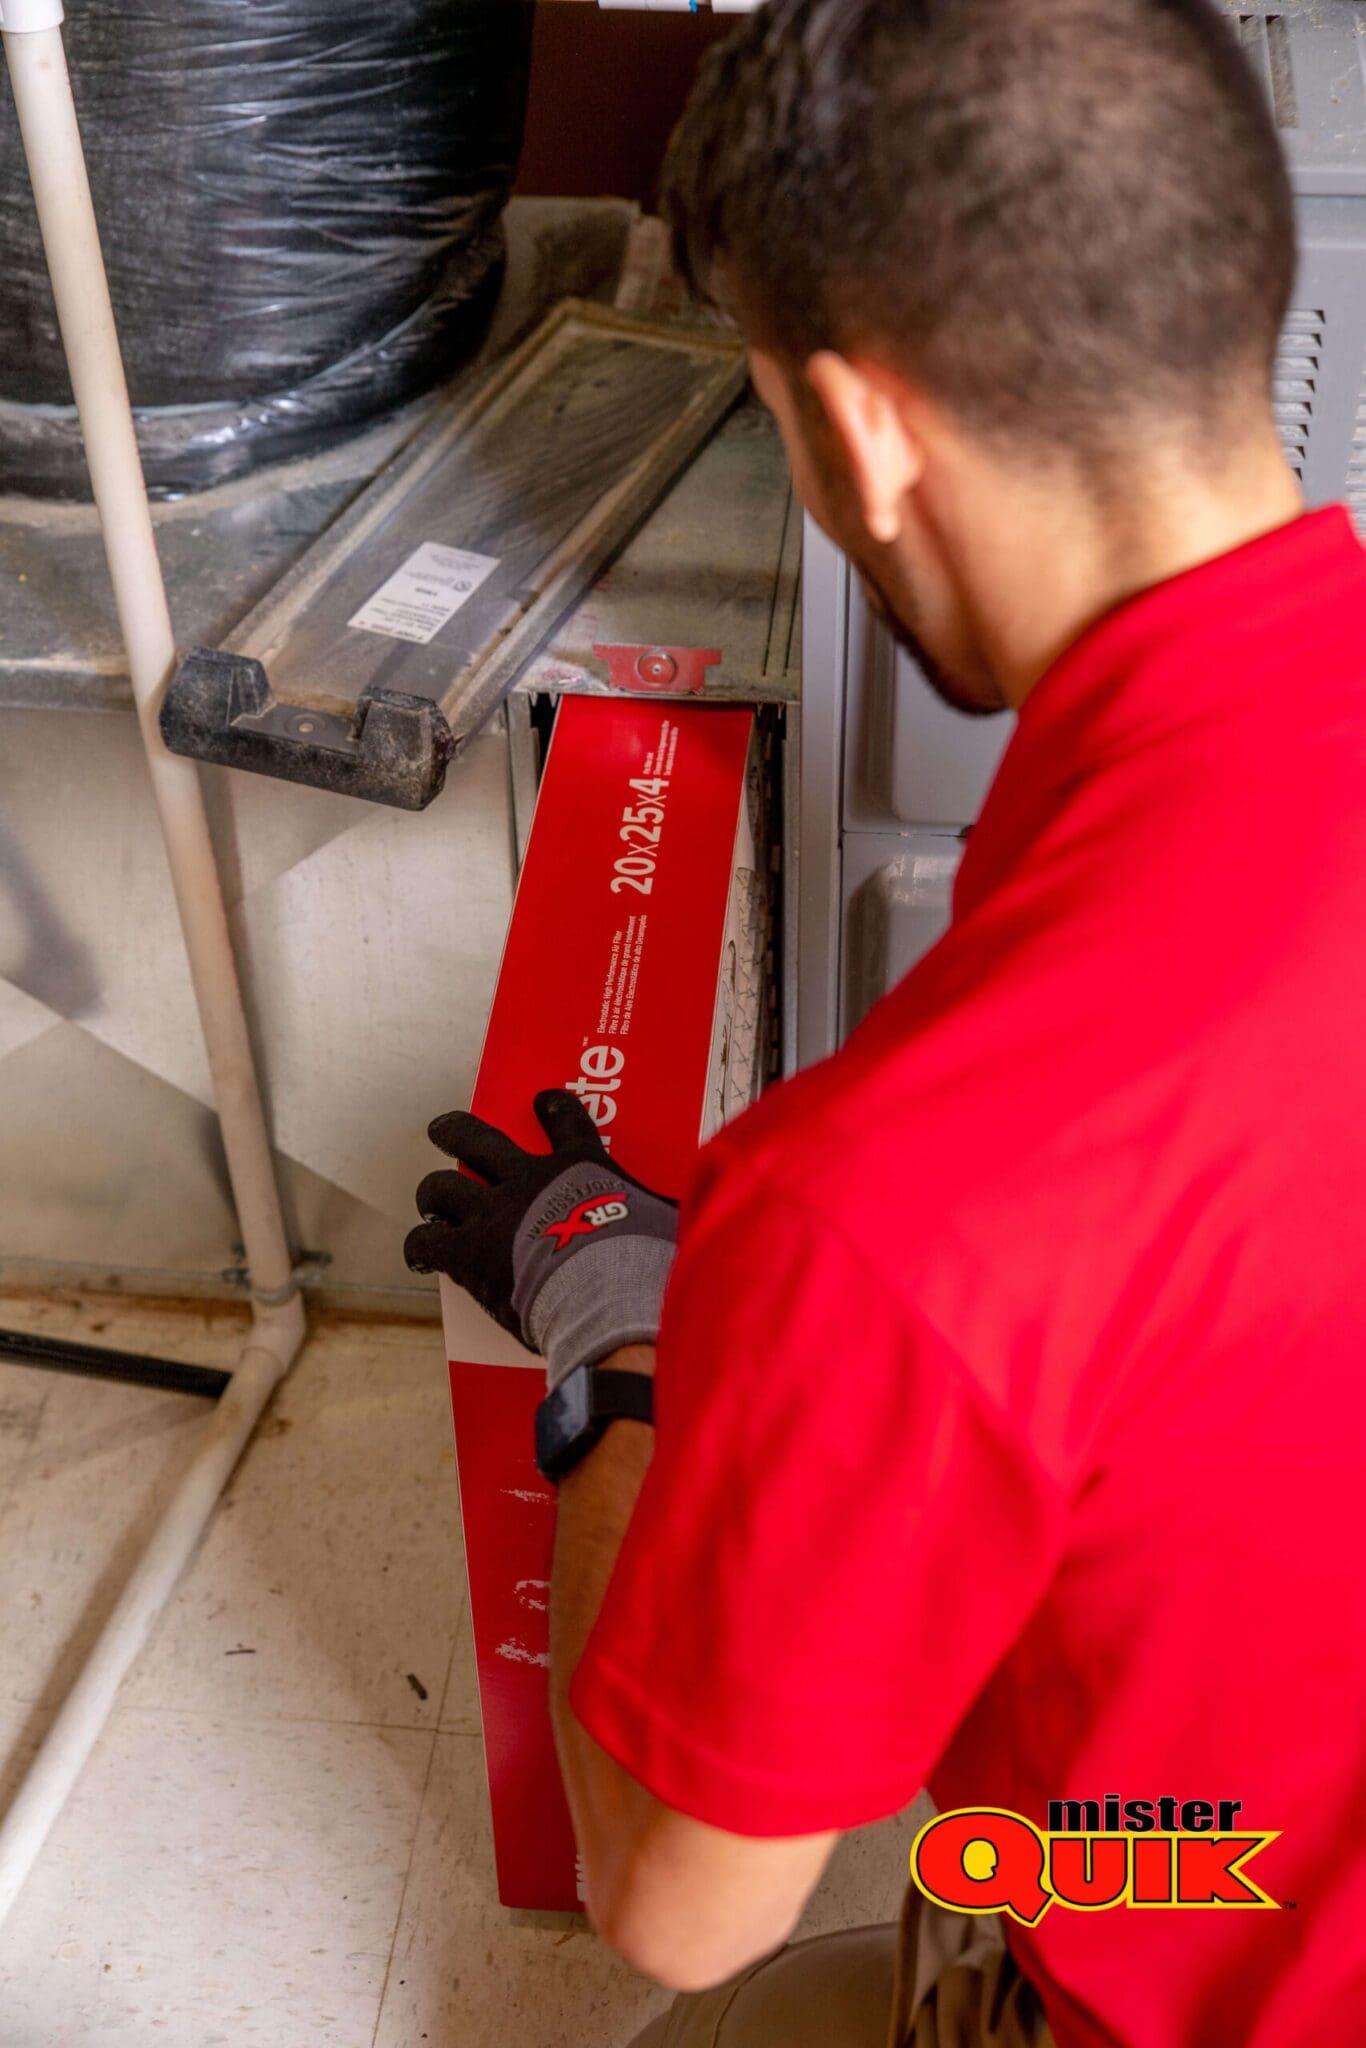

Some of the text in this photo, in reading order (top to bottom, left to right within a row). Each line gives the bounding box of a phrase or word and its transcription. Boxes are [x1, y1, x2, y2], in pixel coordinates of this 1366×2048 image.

[610, 777, 670, 895] 20x25x4
[605, 953, 619, 985] Performance
[603, 986, 614, 999] High
